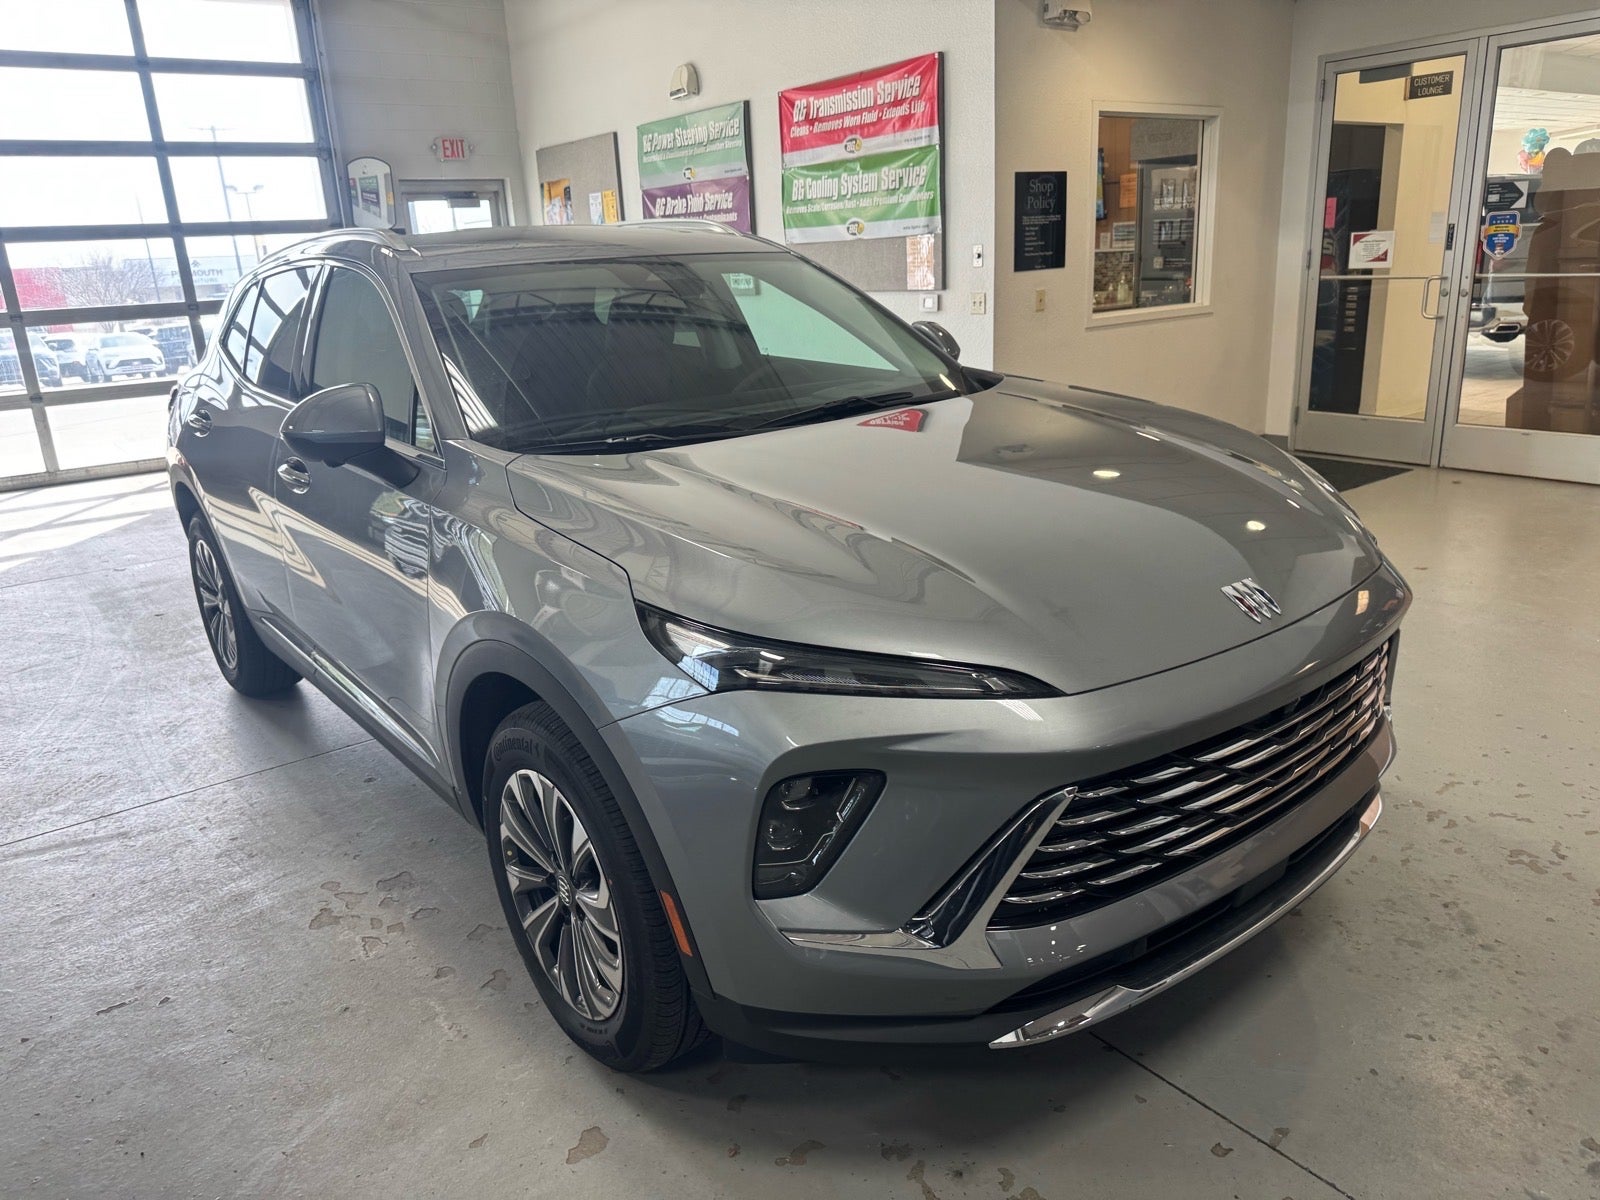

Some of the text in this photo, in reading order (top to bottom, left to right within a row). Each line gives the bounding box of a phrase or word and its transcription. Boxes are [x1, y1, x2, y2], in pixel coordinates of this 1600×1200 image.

[1414, 74, 1450, 86] CUSTOMER
[1418, 85, 1444, 96] LOUNGE
[793, 73, 921, 122] BG Transmission Service
[790, 126, 810, 138] Cleans
[813, 117, 843, 132] Removes
[843, 114, 861, 128] Worn
[861, 109, 879, 124] Fluid
[882, 103, 910, 119] Extends
[652, 131, 675, 151] Power
[674, 124, 708, 147] Steering
[709, 117, 740, 140] Service
[442, 138, 465, 159] EXIT
[792, 163, 927, 202] BG Cooling System Service
[1029, 179, 1054, 196] Shop
[655, 190, 733, 216] BG Brake Fluid Service
[1027, 195, 1055, 213] Policy
[493, 735, 533, 762] Continental
